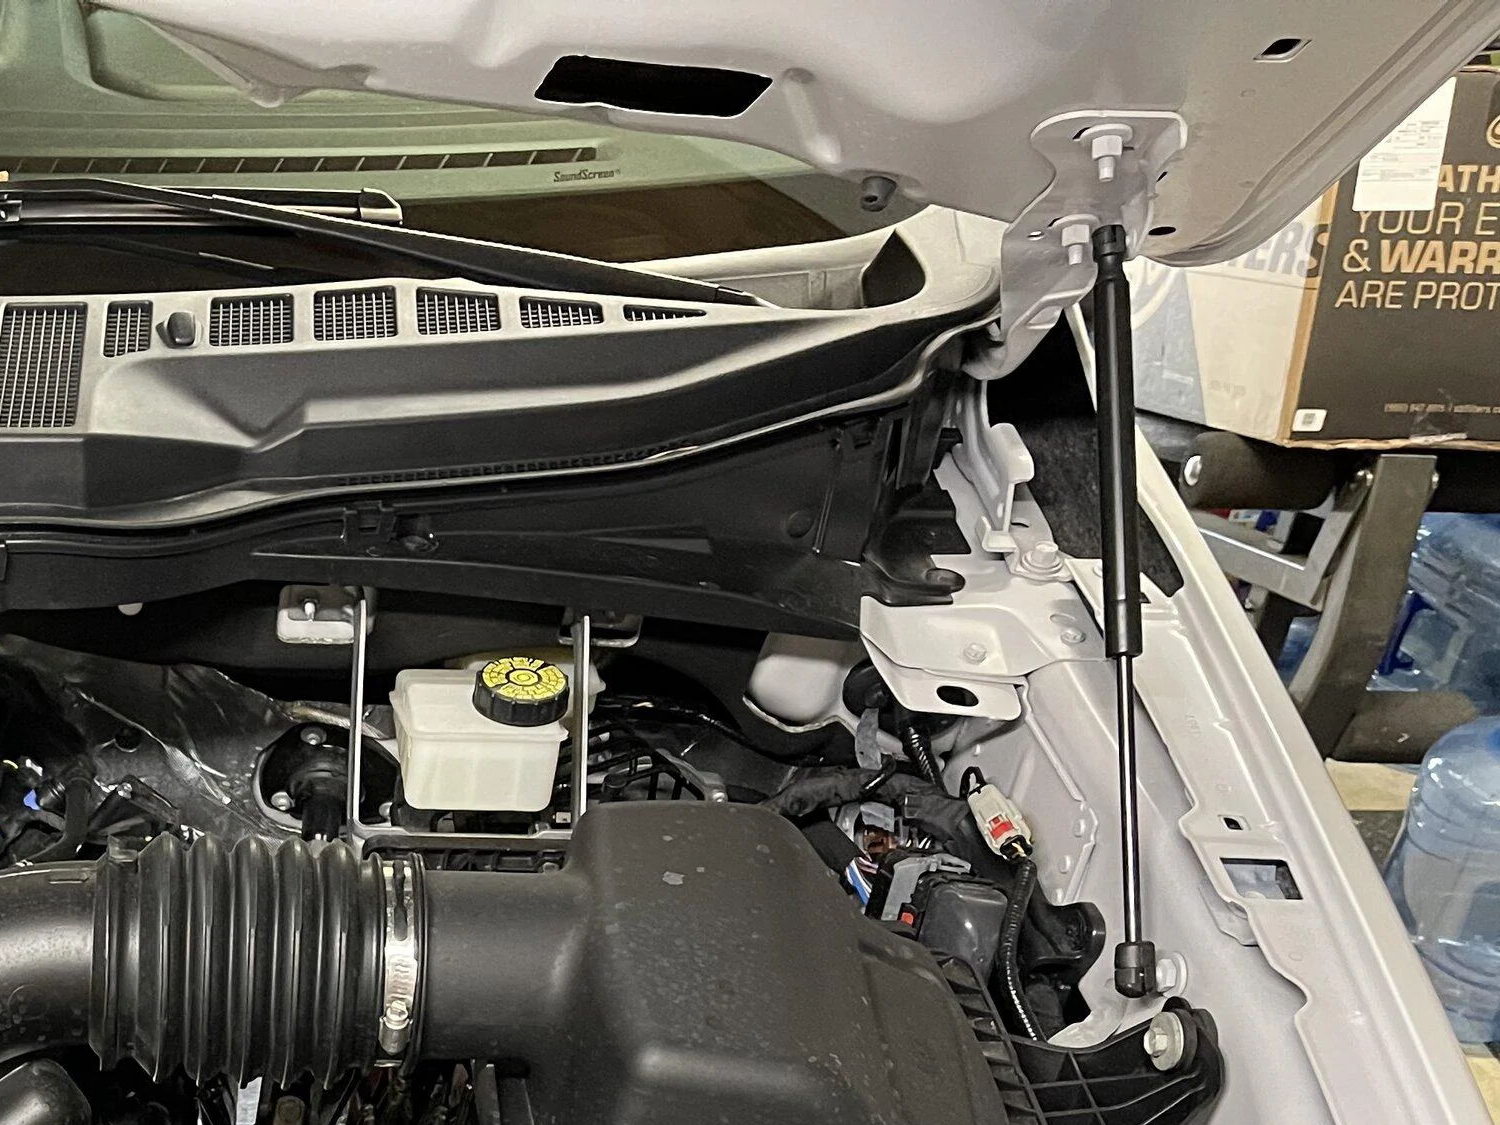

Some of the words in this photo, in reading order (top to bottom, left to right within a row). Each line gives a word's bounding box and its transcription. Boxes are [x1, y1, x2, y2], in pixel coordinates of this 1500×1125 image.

[1358, 202, 1465, 235] YOUR
[1342, 238, 1372, 273] &
[1334, 280, 1407, 309] ARE
